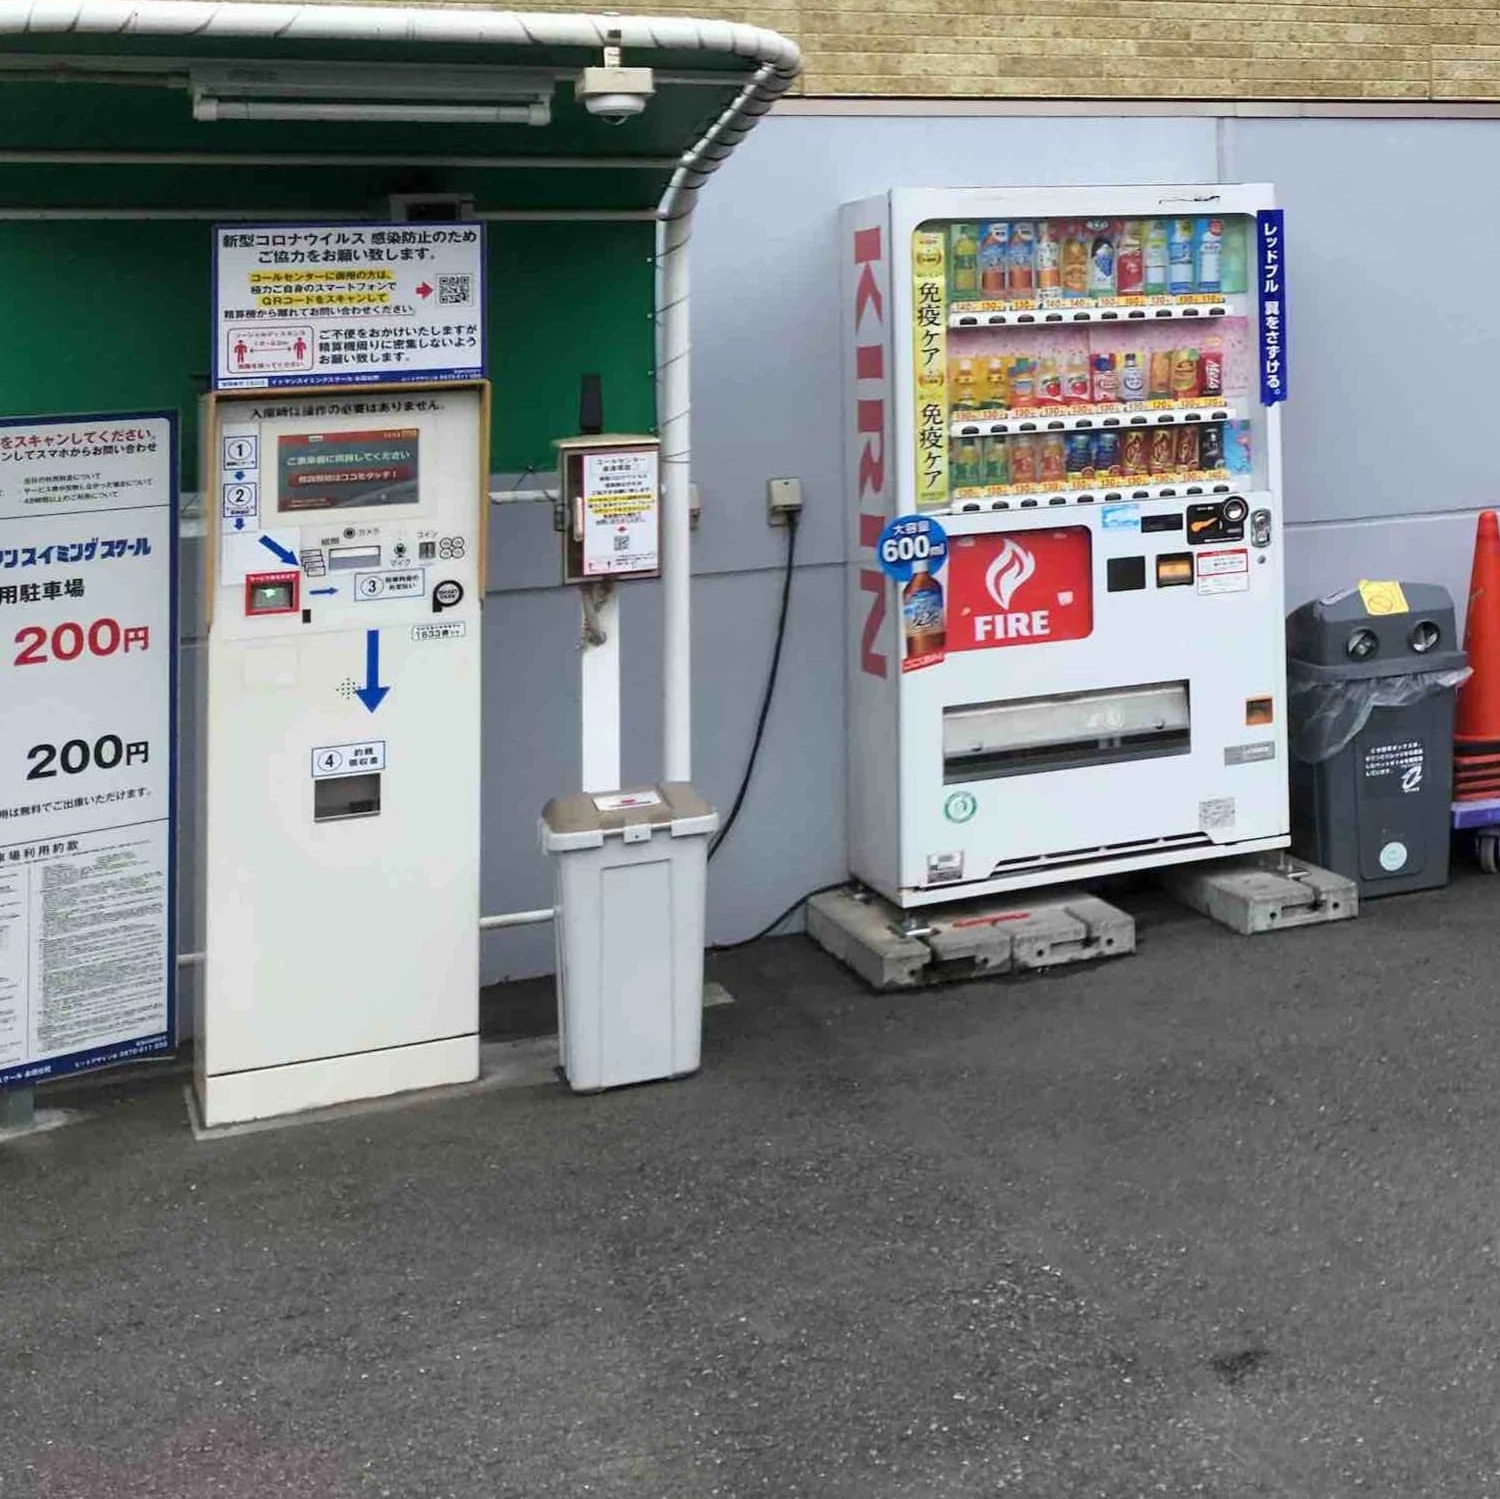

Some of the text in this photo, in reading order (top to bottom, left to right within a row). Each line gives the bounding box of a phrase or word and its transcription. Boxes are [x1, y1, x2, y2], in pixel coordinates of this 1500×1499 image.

[222, 230, 477, 248] 新型コロナウイルス 感染防止のため
[258, 248, 436, 264] ご協力をお願い致します。
[261, 293, 387, 305] QRコードをスキャンして
[319, 325, 478, 340] ご不便をおかけいたしますが
[917, 282, 942, 366] 免疫ケア
[319, 352, 410, 365] お願い致します。
[0, 429, 156, 450] をスキャンしてください。
[918, 403, 944, 489] 免疫ケア
[1, 442, 158, 462] ンしてスマホからお問い合わせ
[853, 226, 888, 680] KIRIN
[893, 519, 931, 536] 大容量
[0, 536, 152, 569] ンスイミングスクール
[973, 609, 1051, 642] FIRE
[13, 617, 150, 667] 200円
[26, 732, 150, 782] 200円
